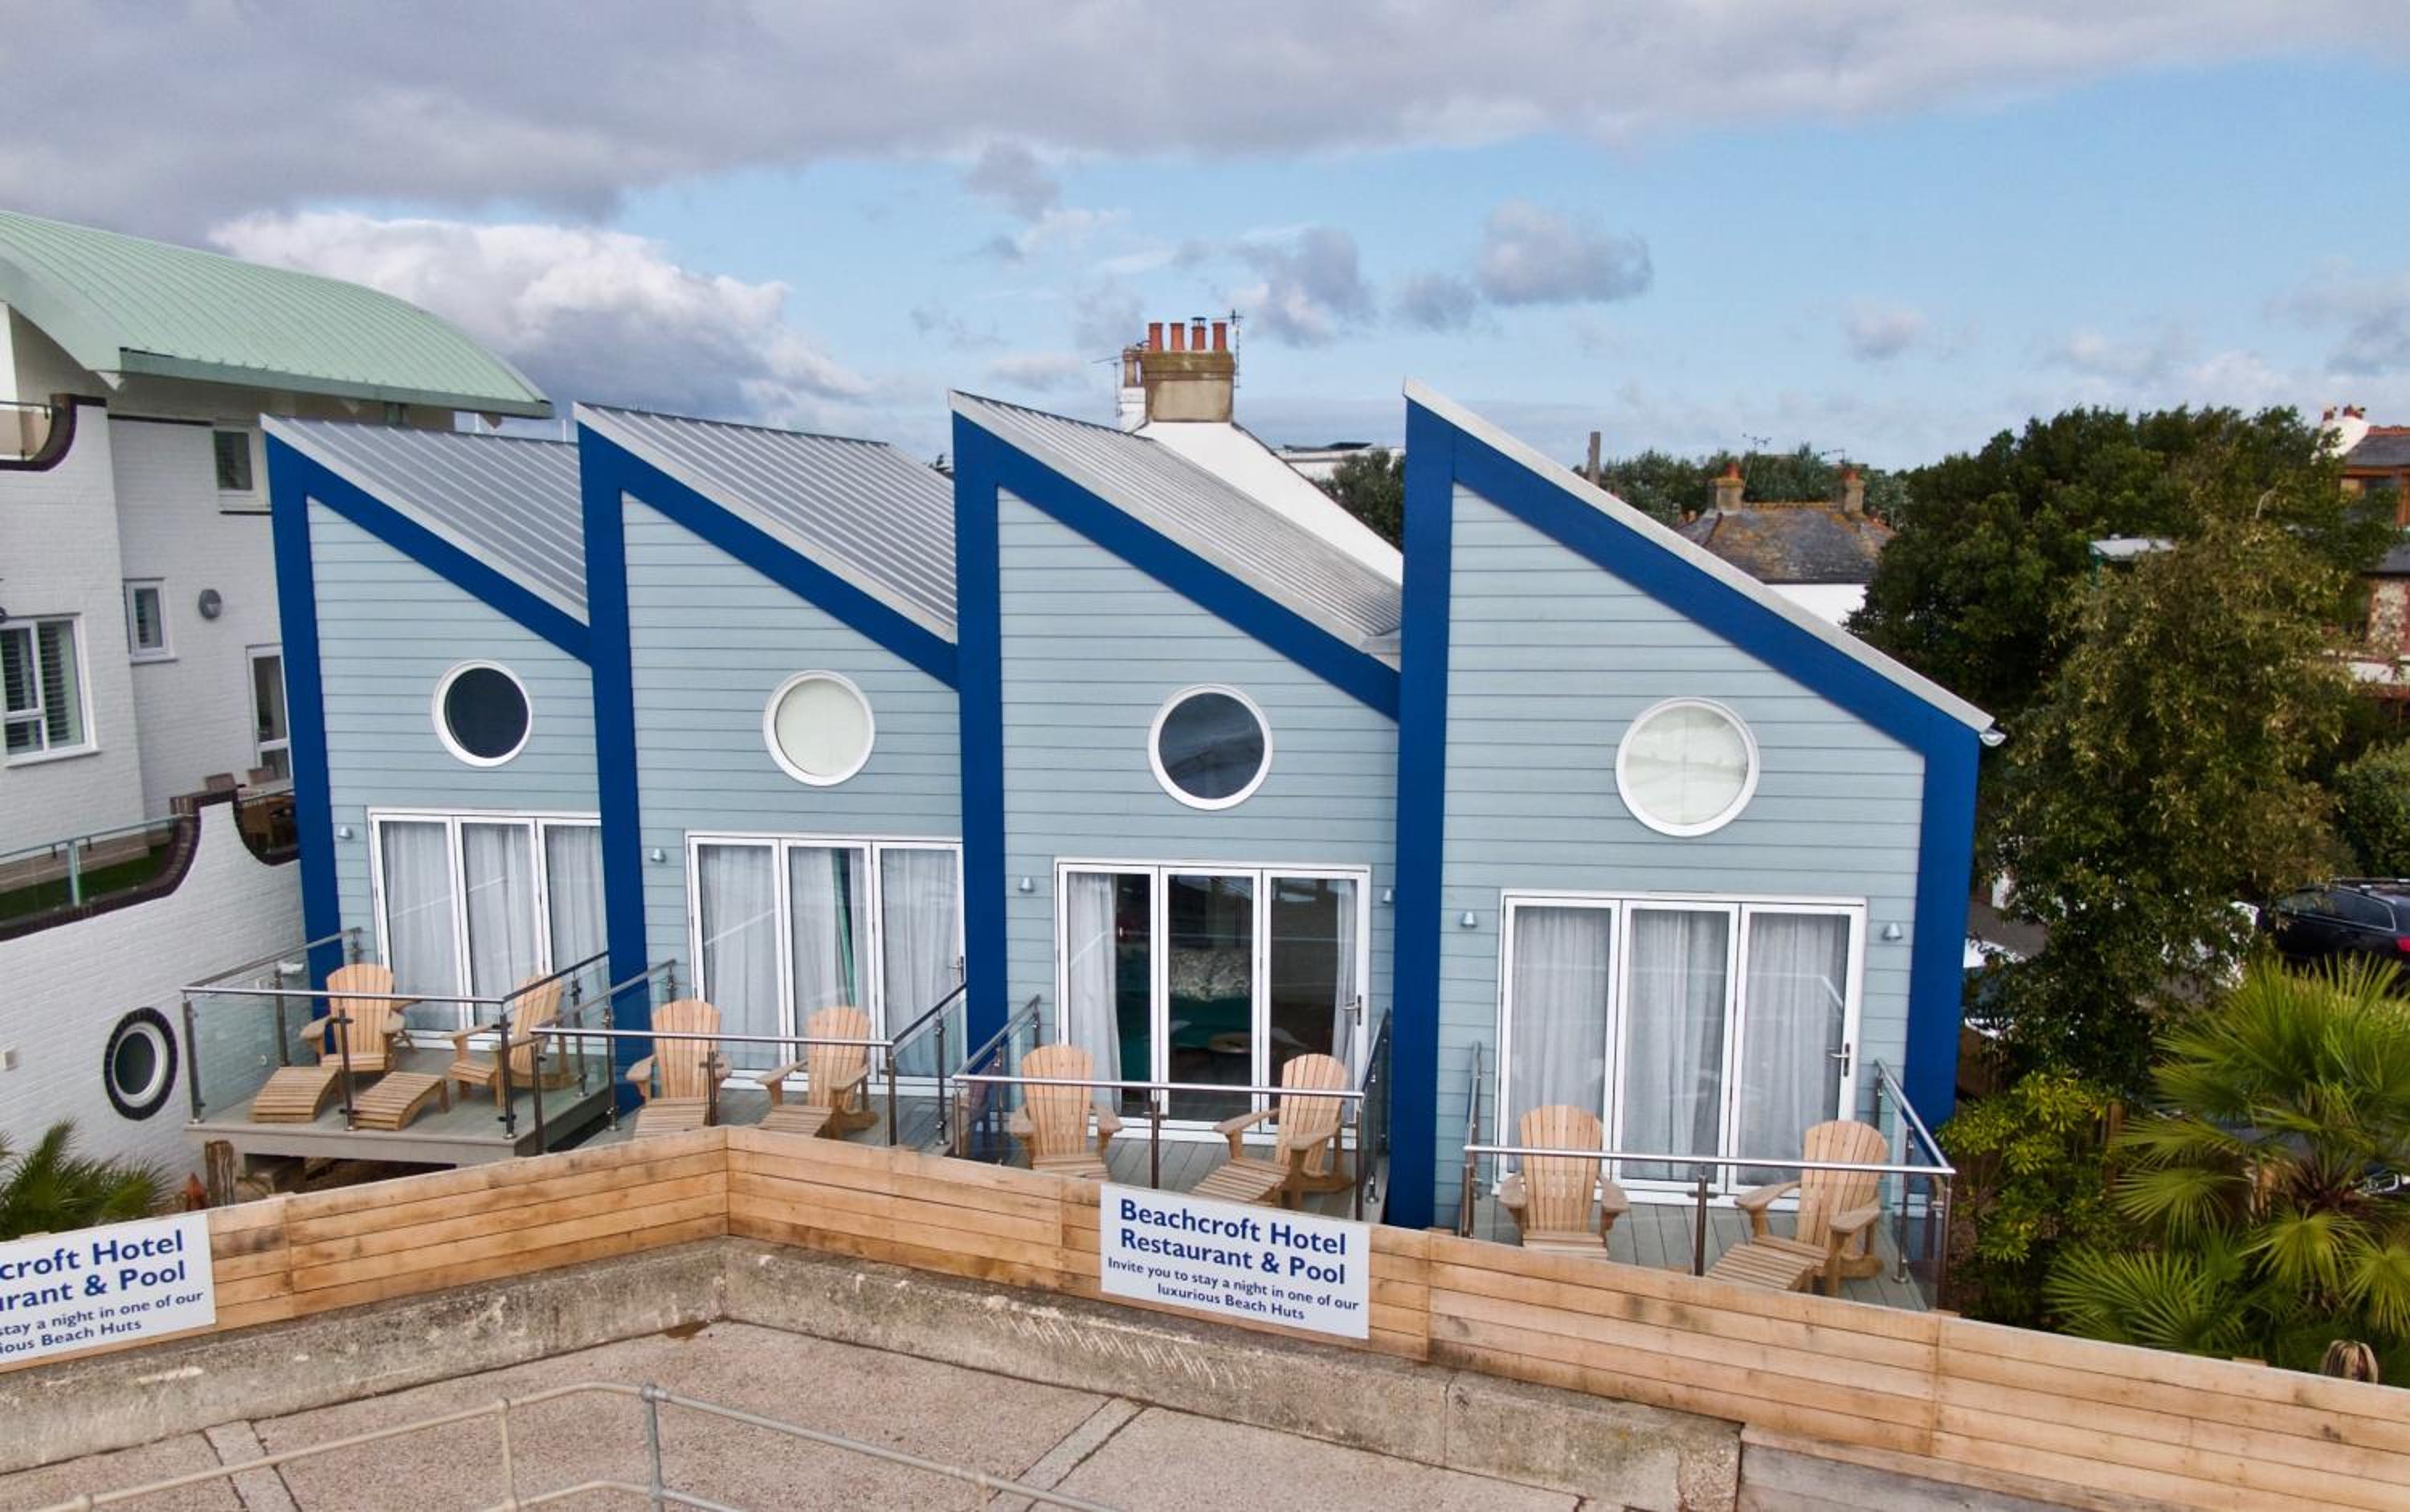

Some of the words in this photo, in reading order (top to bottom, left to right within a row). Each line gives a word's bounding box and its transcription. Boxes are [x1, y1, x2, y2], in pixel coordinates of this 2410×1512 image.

[1120, 1198, 1261, 1242] Beachcroft
[1270, 1222, 1346, 1256] Hotel
[92, 1229, 184, 1265] Hotel
[1121, 1228, 1253, 1270] Restaurant
[1261, 1252, 1281, 1274] &
[1289, 1256, 1346, 1285] Pool
[84, 1274, 108, 1297] &
[120, 1260, 186, 1291] Pool
[1108, 1257, 1144, 1274] Invite
[1147, 1265, 1171, 1280] you
[1174, 1270, 1189, 1282] to
[1192, 1272, 1219, 1289] stay
[1223, 1278, 1231, 1289] a
[1234, 1279, 1268, 1297] night
[1272, 1285, 1285, 1299] in
[1288, 1290, 1313, 1304] one
[1317, 1293, 1332, 1307] of
[1334, 1297, 1360, 1311] our
[37, 1320, 47, 1330] a
[51, 1310, 94, 1328] night
[100, 1307, 115, 1320] in
[120, 1303, 151, 1315] one
[156, 1294, 172, 1309] of
[176, 1291, 204, 1305] our
[1158, 1283, 1221, 1305] luxurious
[1225, 1293, 1267, 1314] Beach
[1271, 1302, 1305, 1321] Huts
[41, 1326, 95, 1347] Beach
[100, 1318, 142, 1336] Huts
